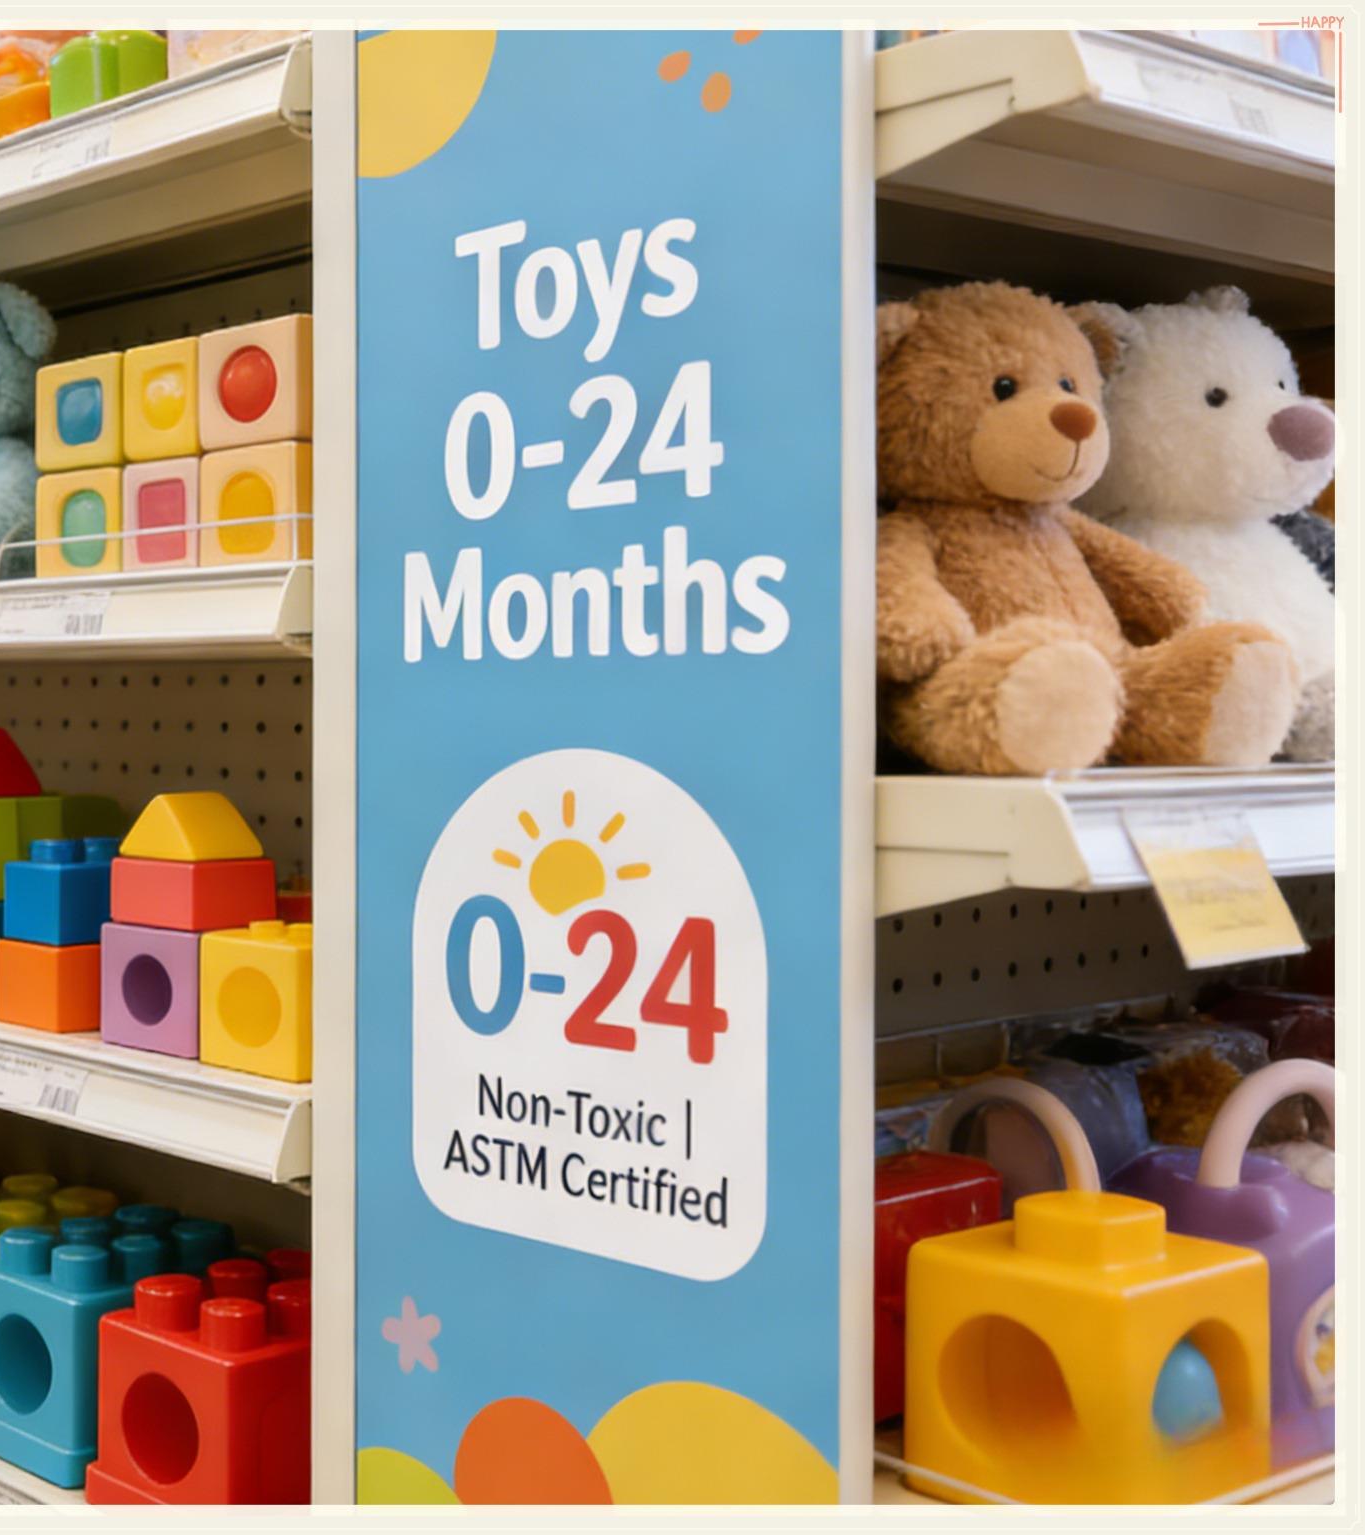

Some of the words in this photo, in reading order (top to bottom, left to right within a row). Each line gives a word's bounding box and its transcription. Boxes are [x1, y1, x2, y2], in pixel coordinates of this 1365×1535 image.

[455, 218, 699, 362] Toys
[444, 360, 724, 520] 0-24
[403, 525, 790, 663] Months
[446, 893, 728, 1064] 0-24
[444, 1130, 547, 1190] ASTM
[561, 1152, 728, 1228] Certified
[477, 1073, 667, 1147] Non-Toxic
